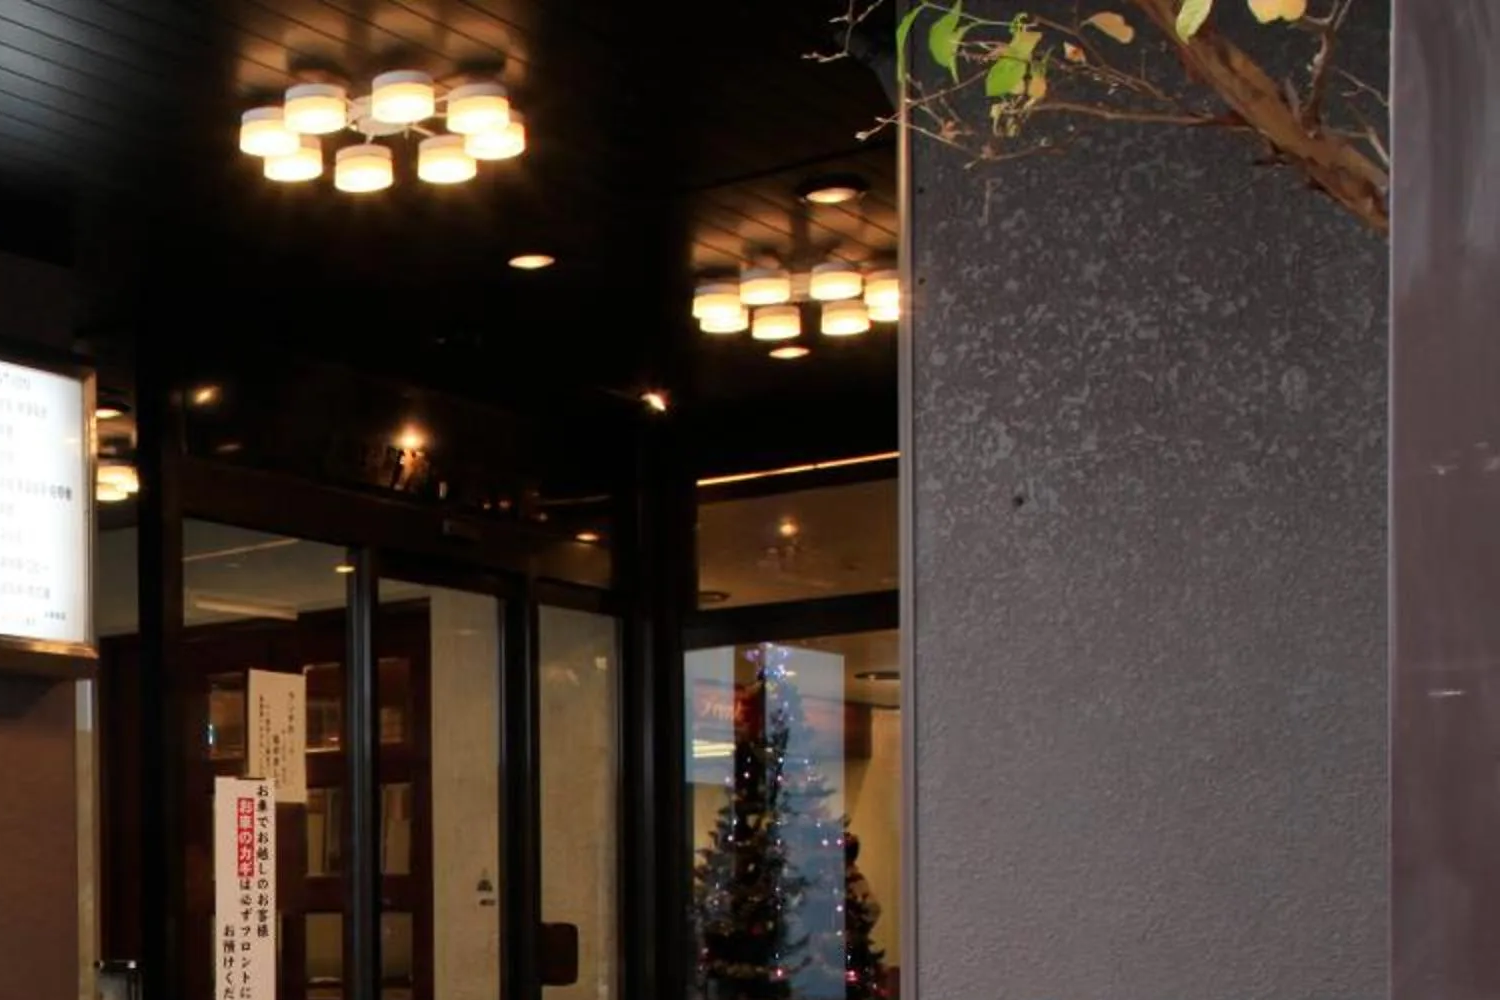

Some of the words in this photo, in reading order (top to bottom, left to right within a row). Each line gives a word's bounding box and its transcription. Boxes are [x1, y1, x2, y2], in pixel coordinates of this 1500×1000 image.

[256, 784, 269, 938] お車でお越しのお客様
